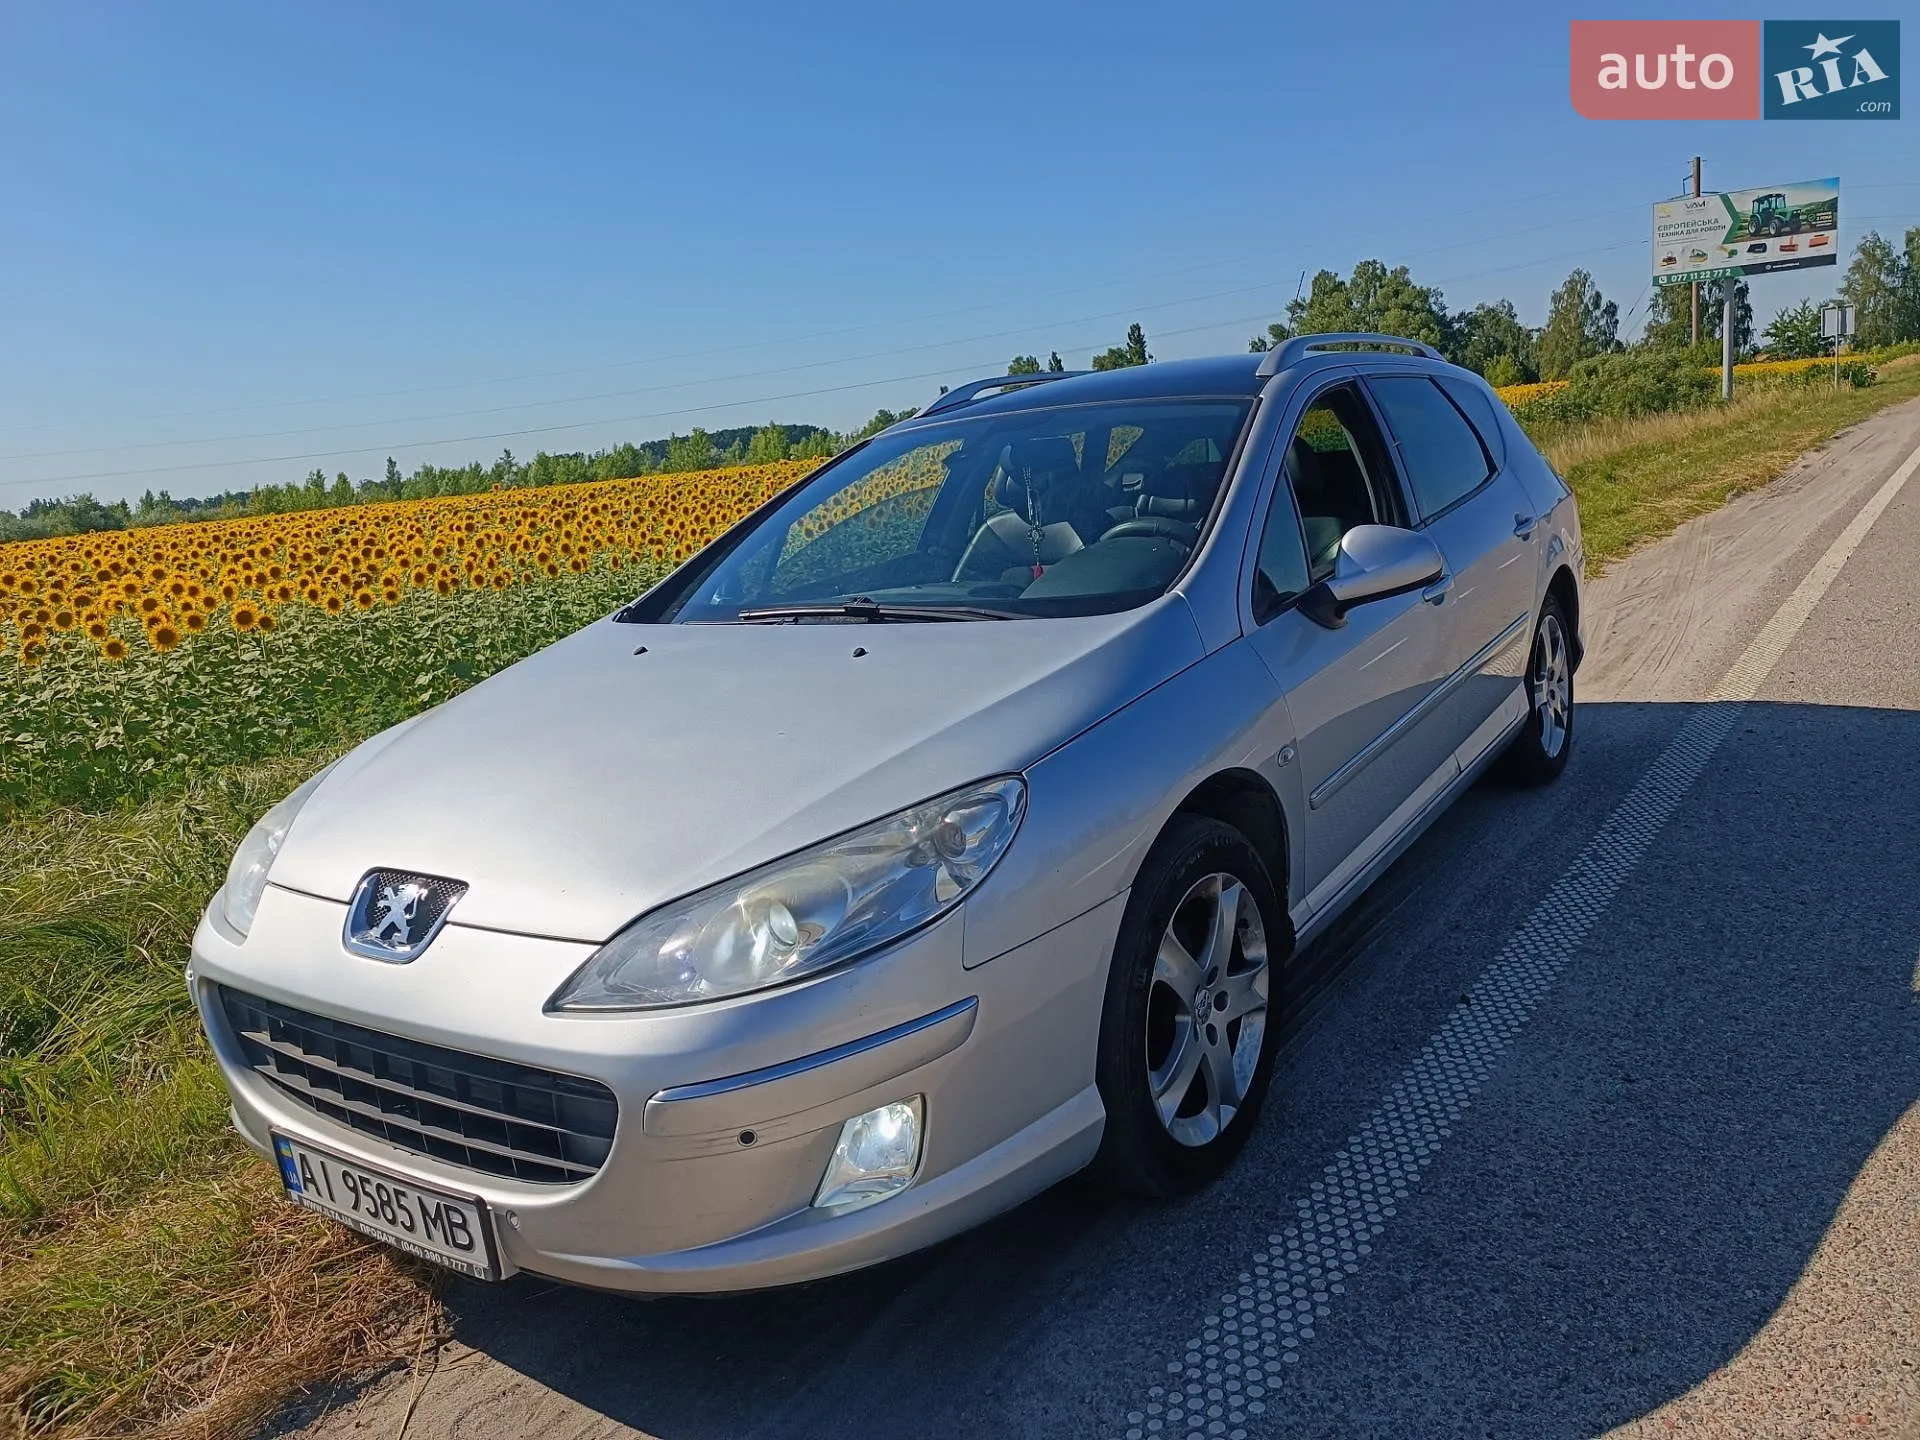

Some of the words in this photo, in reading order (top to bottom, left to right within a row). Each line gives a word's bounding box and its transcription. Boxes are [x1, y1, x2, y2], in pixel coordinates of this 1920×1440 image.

[1657, 217, 1719, 232] ЄВРОПЕЙСЬКА
[1658, 230, 1685, 239] ТЕХНІКА
[1685, 228, 1699, 236] ДЛЯ
[1700, 225, 1726, 233] РОБОТИ
[1671, 274, 1688, 282] 077
[1700, 271, 1711, 279] 22
[1713, 269, 1723, 277] 77
[286, 1170, 300, 1186] UA
[298, 1153, 337, 1204] AI
[341, 1169, 417, 1233] 9585
[417, 1195, 474, 1252] MB
[359, 1223, 397, 1246] ПРОДАЖ
[401, 1240, 423, 1258] (044)
[450, 1258, 467, 1272] 777
